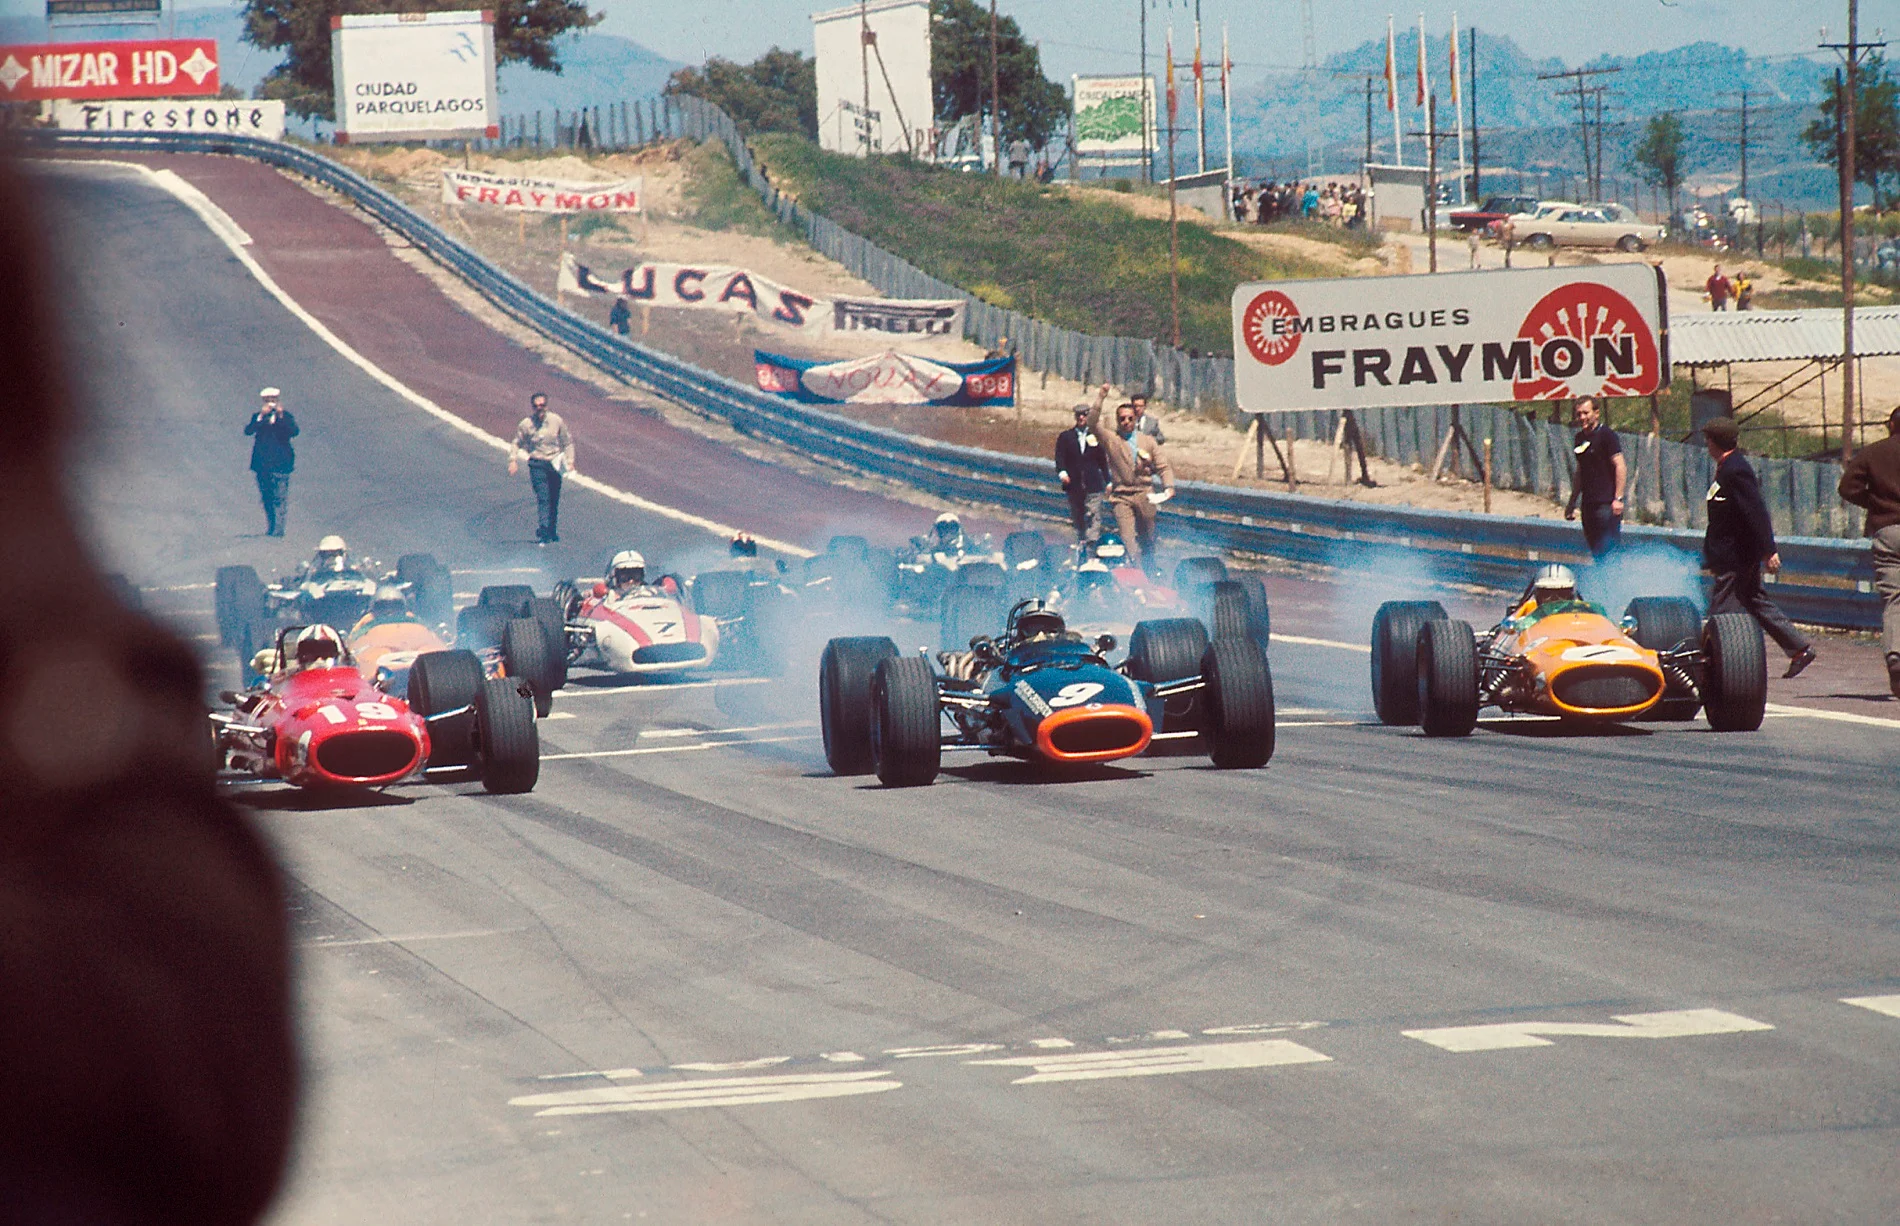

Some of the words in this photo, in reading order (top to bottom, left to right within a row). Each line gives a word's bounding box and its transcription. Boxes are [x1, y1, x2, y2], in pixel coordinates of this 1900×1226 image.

[31, 51, 119, 88] MIZAR
[131, 50, 178, 85] HD
[355, 82, 418, 96] CIUDAD
[81, 105, 263, 129] Firestone
[355, 98, 484, 115] PARQUELAGOS
[456, 185, 637, 210] FRAYMON
[577, 264, 814, 327] LUCAS
[1271, 308, 1470, 336] EMBRAGUES
[1311, 336, 1636, 390] FRAYMON
[1048, 682, 1105, 707] 9
[317, 701, 398, 724] 19
